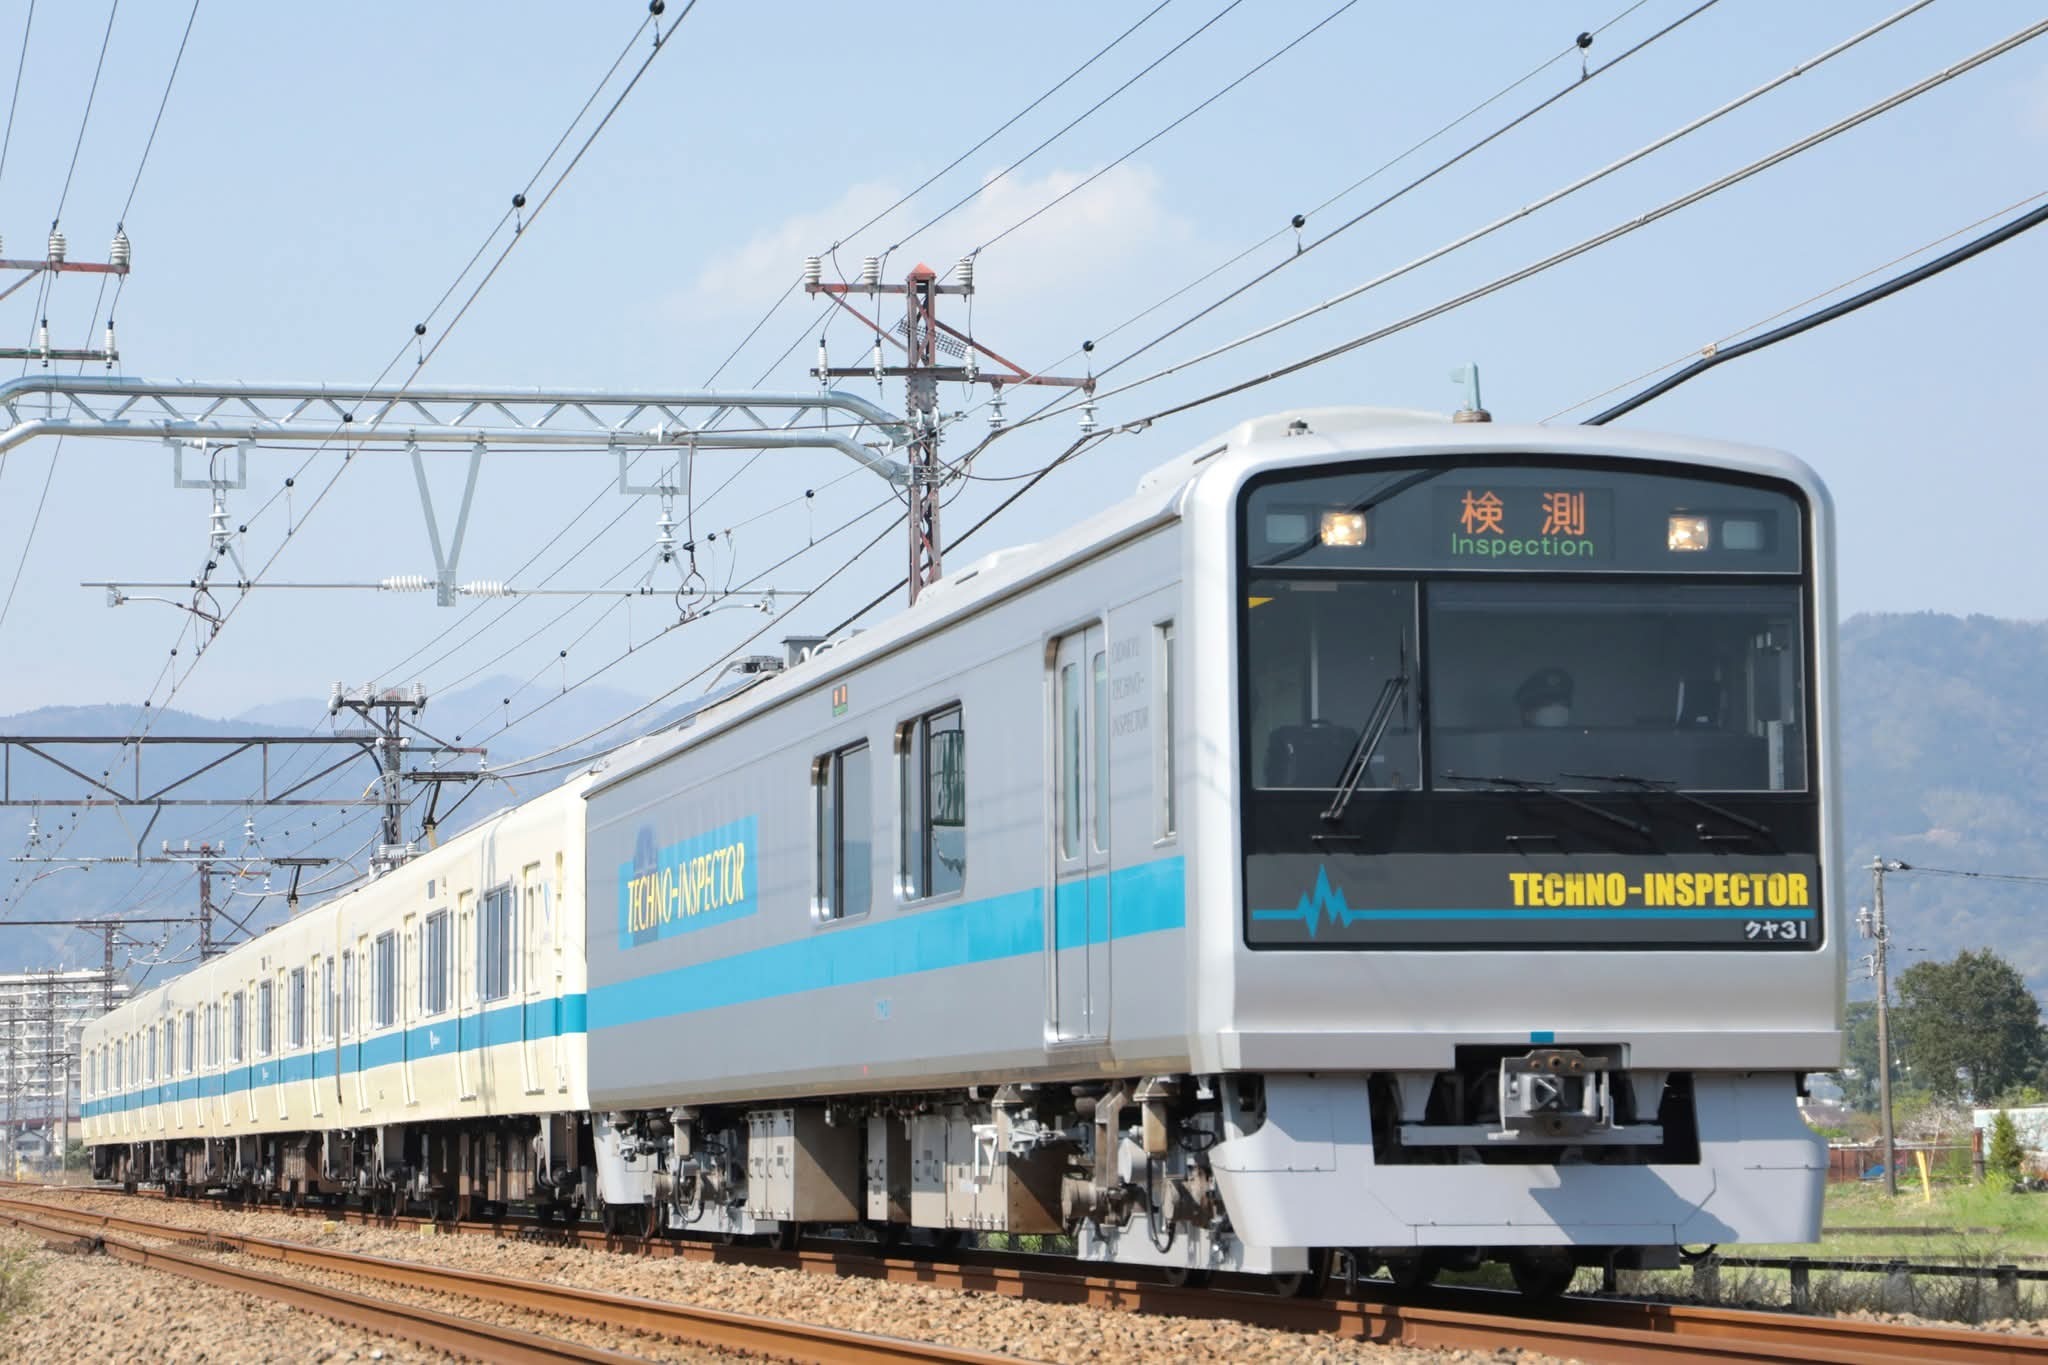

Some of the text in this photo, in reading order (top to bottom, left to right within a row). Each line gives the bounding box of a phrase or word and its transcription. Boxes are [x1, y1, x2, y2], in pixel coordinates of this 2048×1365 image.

[1461, 490, 1585, 535] 検測
[1451, 532, 1595, 558] Inspection
[627, 842, 745, 933] TECHNO-INSPECTOR
[1509, 873, 1809, 906] TECHNO-INSPECTOR
[1745, 920, 1807, 940] クヤ31
